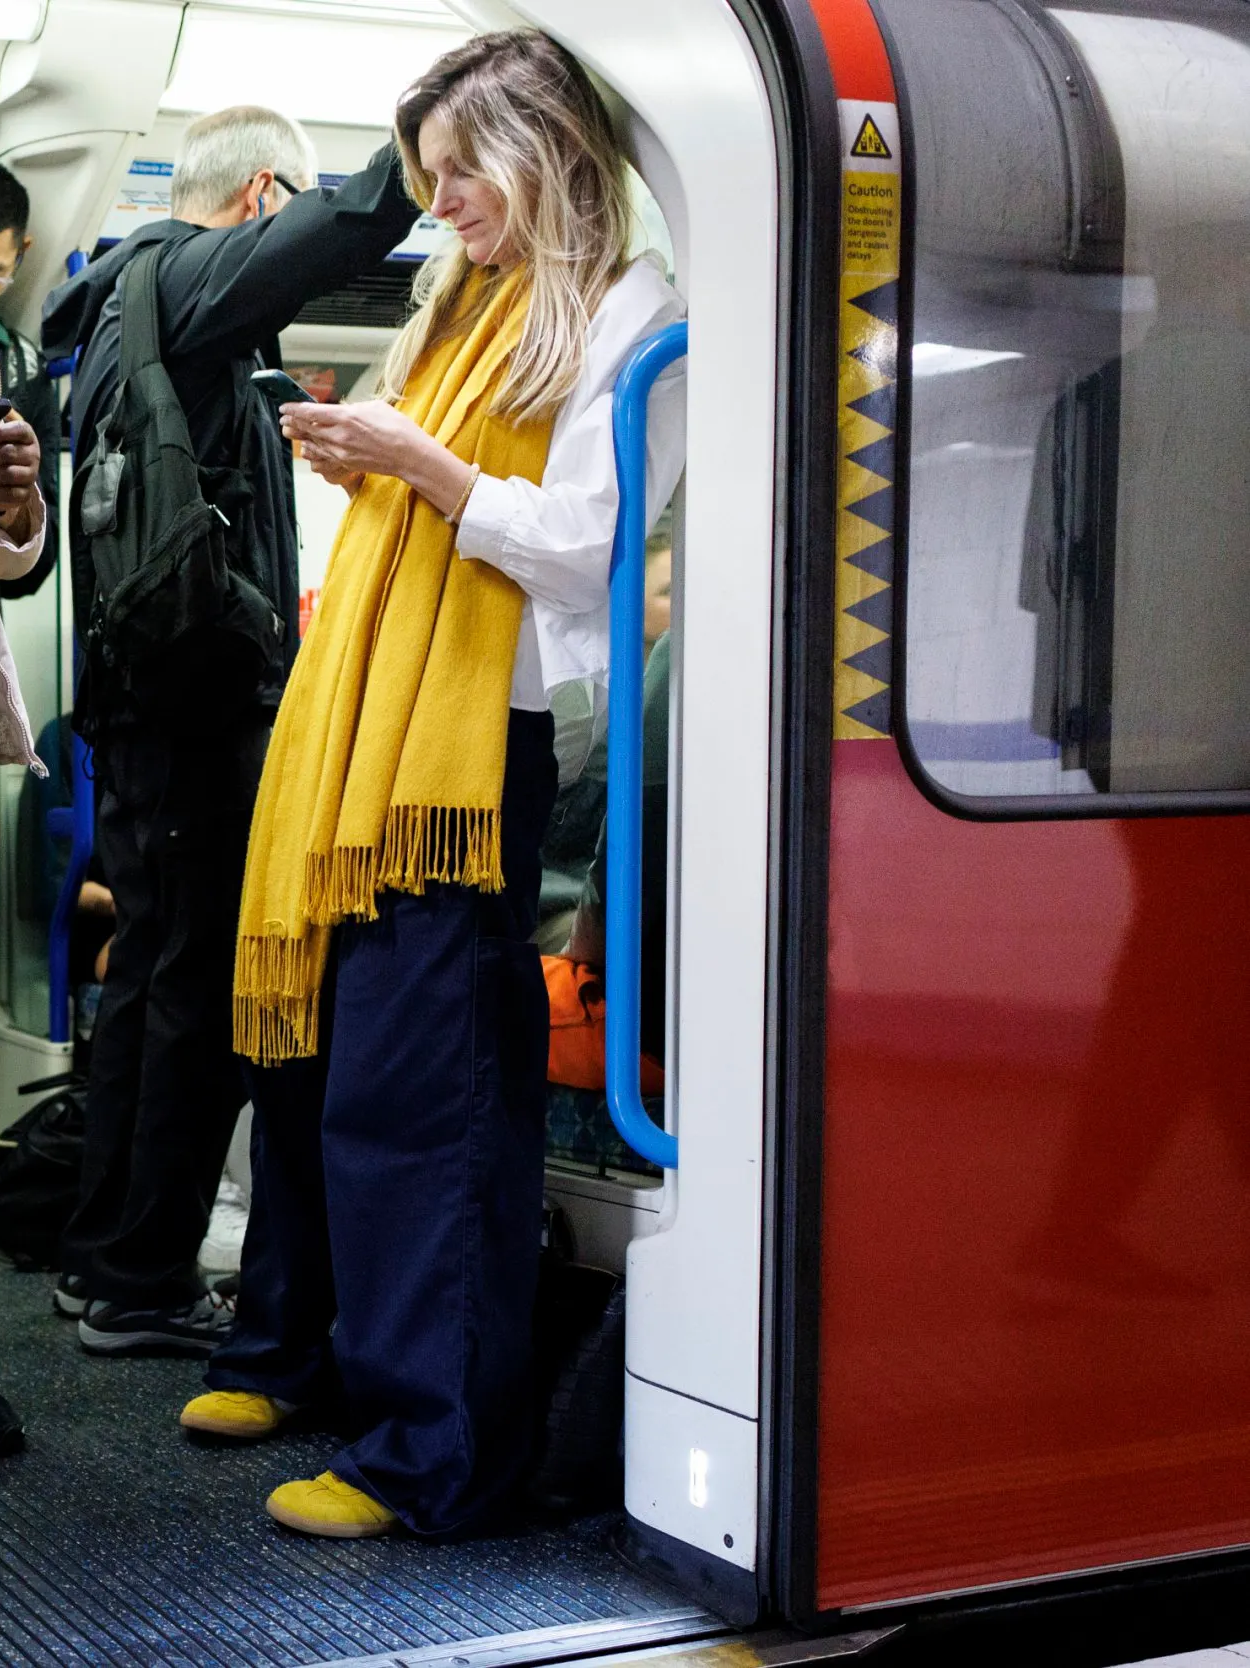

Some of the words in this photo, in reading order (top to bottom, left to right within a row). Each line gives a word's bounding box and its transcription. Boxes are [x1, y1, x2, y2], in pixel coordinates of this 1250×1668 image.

[848, 183, 893, 197] Caution
[847, 204, 893, 218] Obstructing
[848, 217, 861, 226] the
[862, 217, 885, 227] doors
[847, 229, 887, 239] dangerous
[846, 240, 862, 249] and
[847, 251, 872, 261] delays
